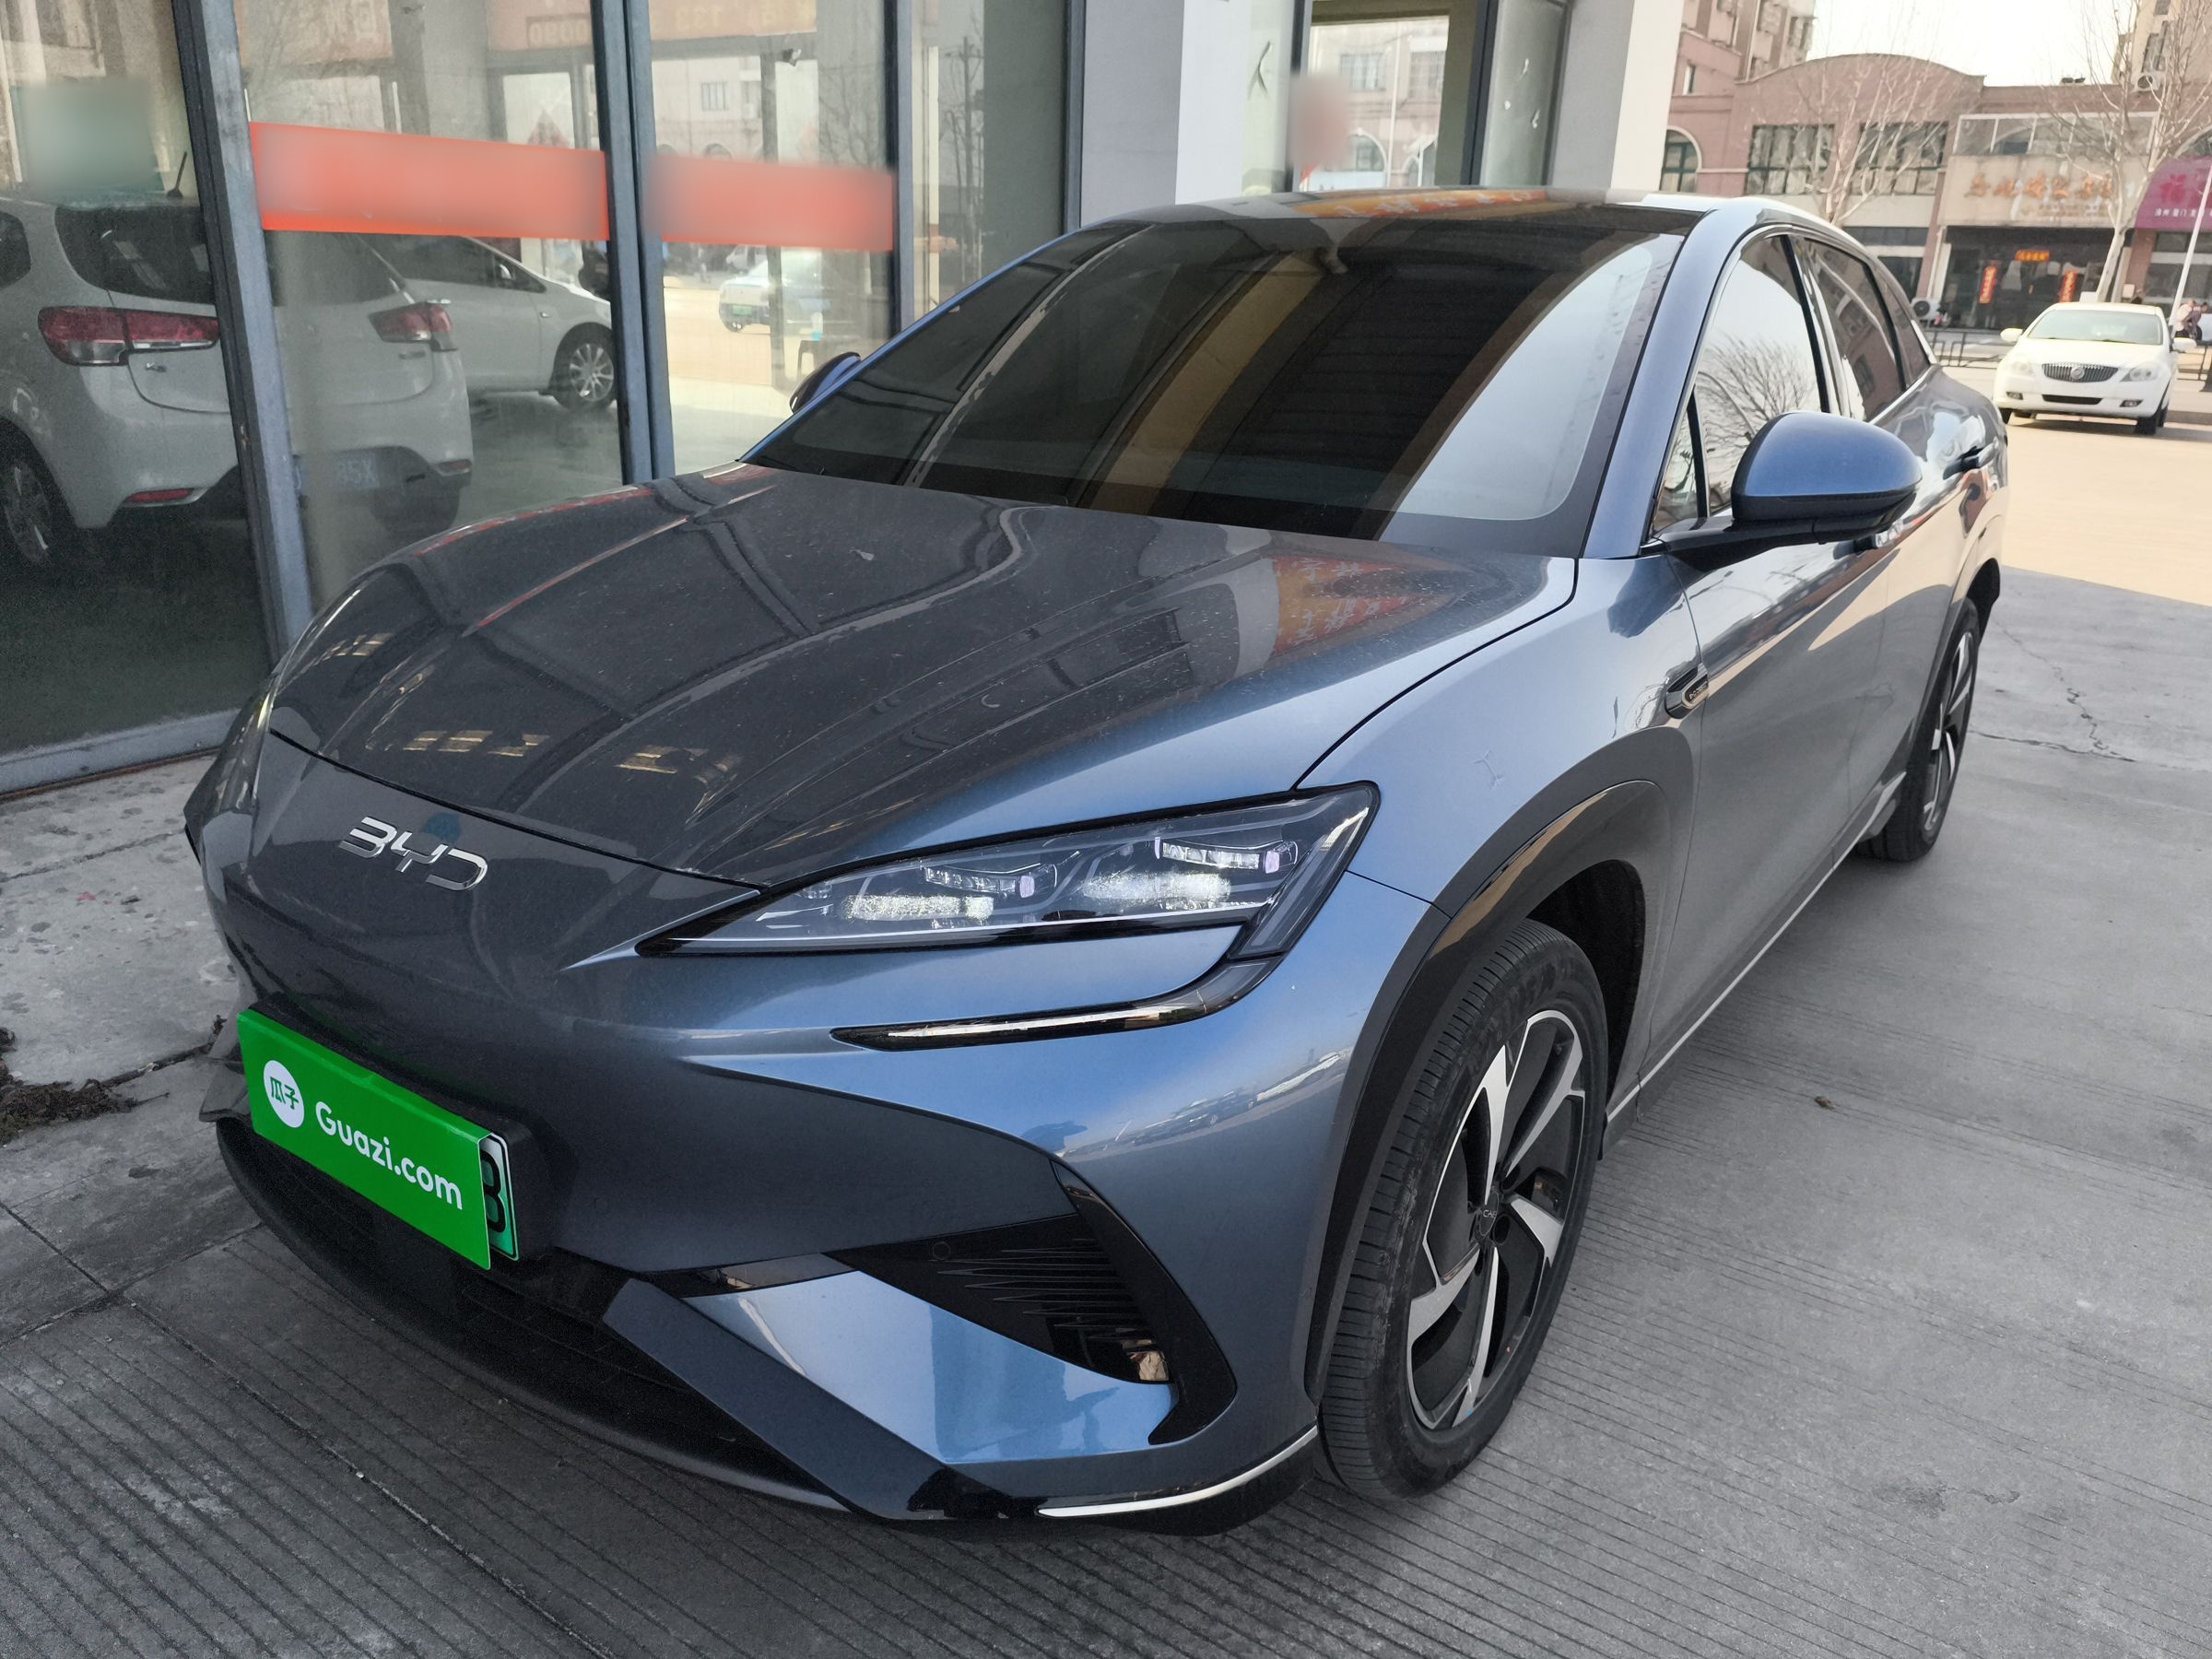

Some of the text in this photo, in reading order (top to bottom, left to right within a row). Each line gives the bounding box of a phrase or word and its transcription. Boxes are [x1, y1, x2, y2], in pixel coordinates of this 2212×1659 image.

[338, 817, 488, 890] BYD
[270, 1077, 300, 1110] 瓜子
[315, 1101, 463, 1210] Guazi.com
